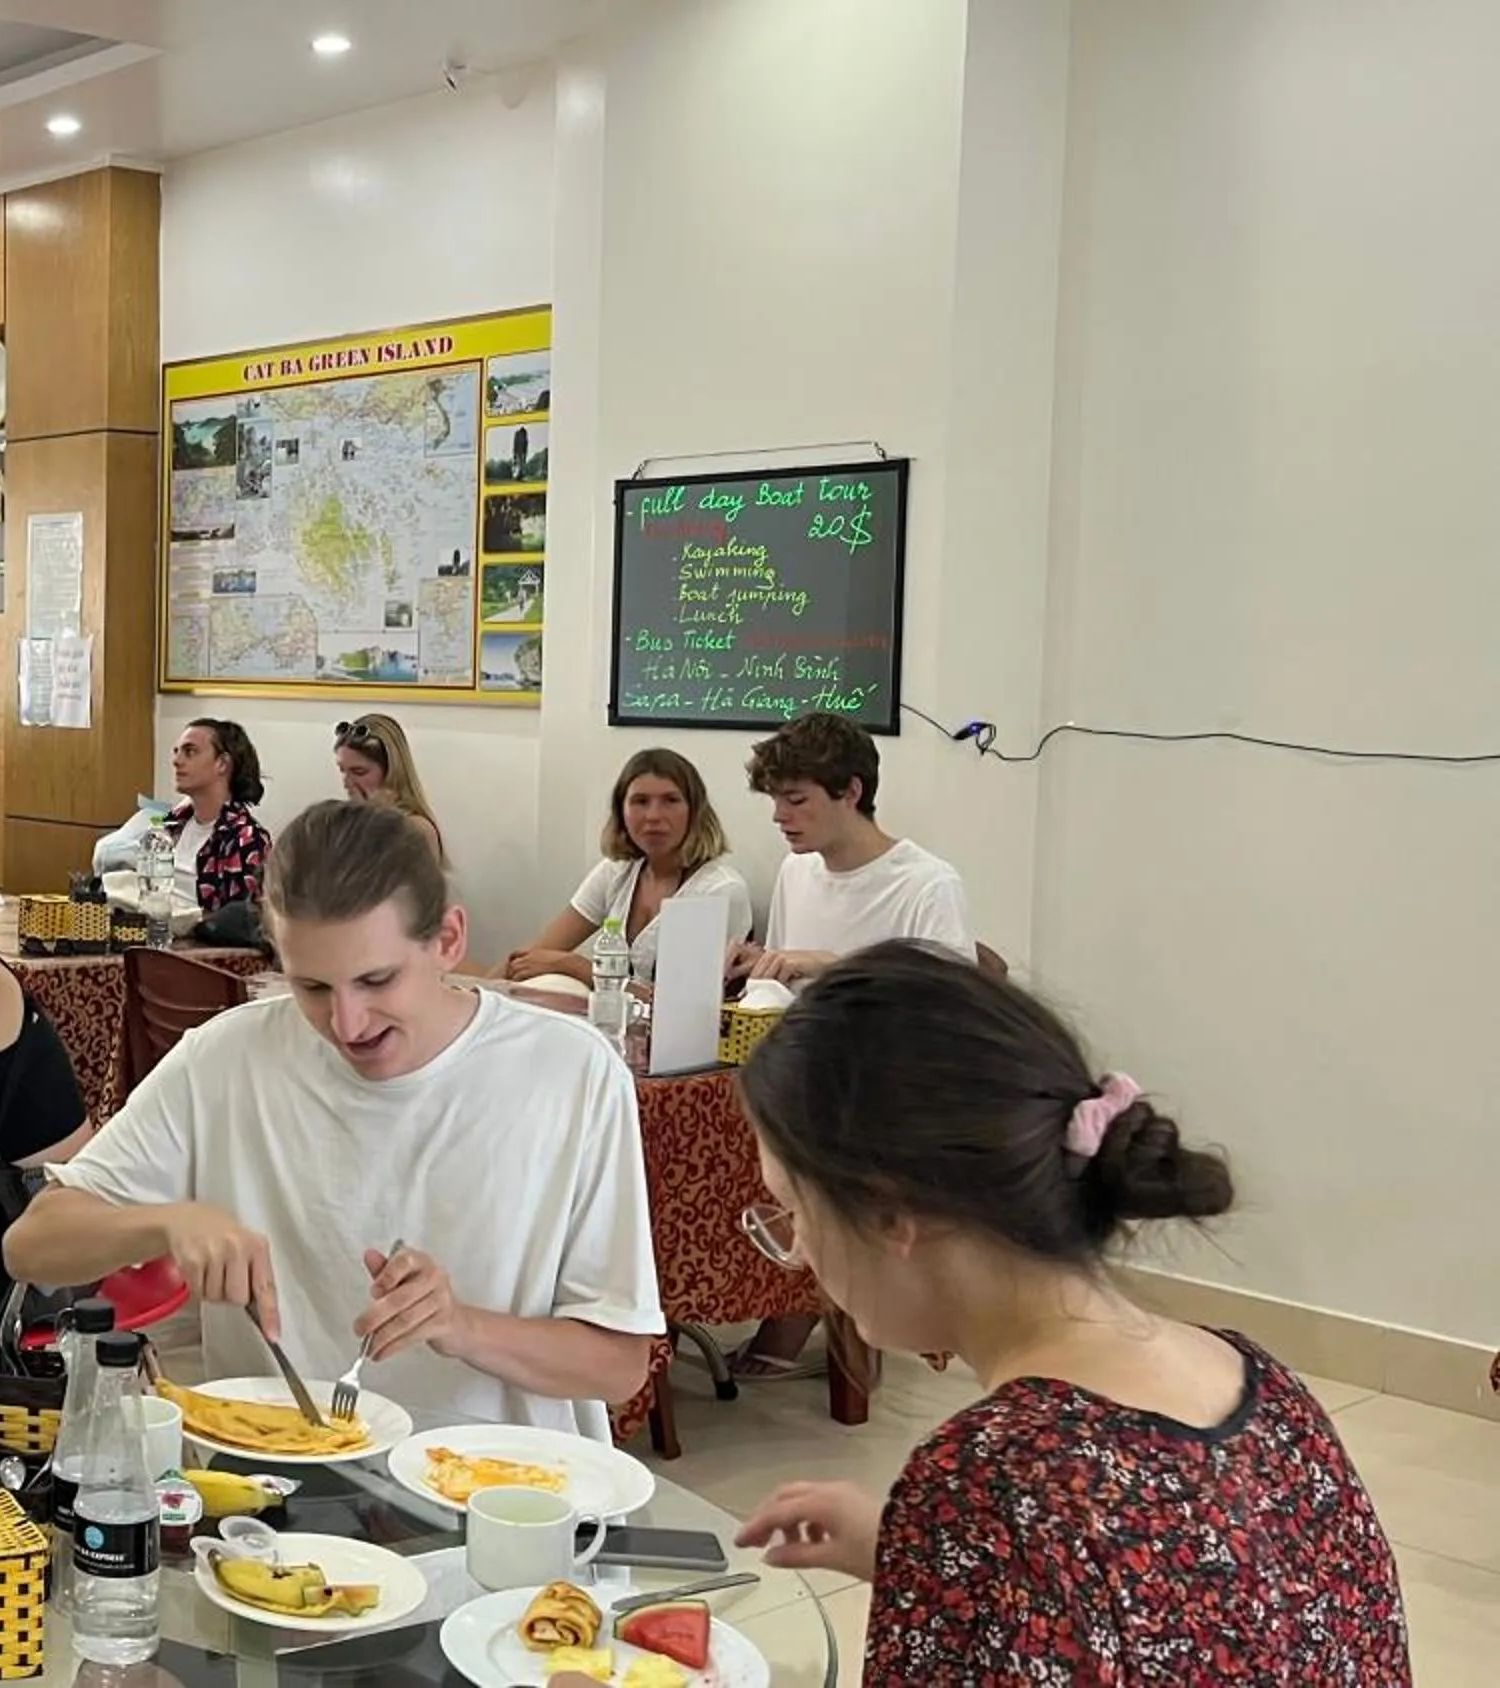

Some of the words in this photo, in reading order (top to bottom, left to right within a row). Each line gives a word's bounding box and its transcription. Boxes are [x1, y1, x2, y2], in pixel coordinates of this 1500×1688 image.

[243, 361, 274, 382] CAT
[280, 358, 303, 377] BA
[308, 347, 371, 373] GREEN
[377, 336, 453, 363] ISLAND
[699, 487, 744, 522] day
[755, 481, 805, 506] Boat
[806, 504, 873, 555] 20$
[678, 563, 776, 590] Swimming
[679, 602, 744, 624] Lunch
[635, 629, 673, 651] Bus
[683, 629, 736, 650] Ticket
